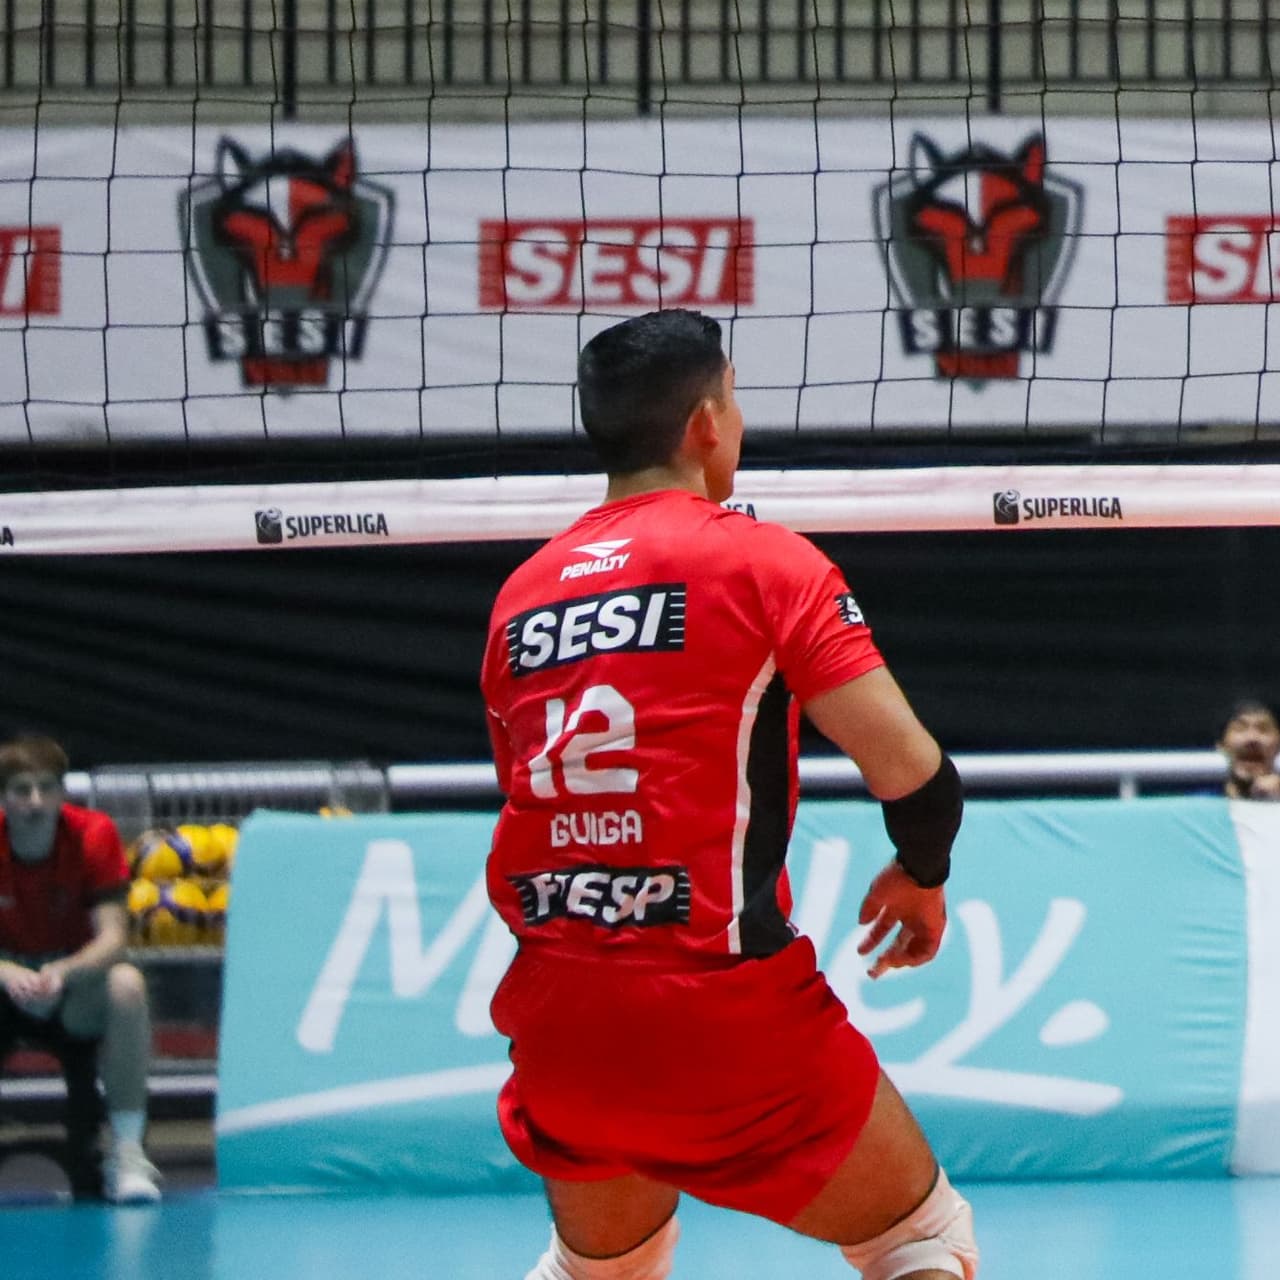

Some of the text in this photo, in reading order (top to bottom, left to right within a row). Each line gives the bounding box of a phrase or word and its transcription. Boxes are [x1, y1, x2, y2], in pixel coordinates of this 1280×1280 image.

[505, 228, 731, 301] SESI
[286, 515, 388, 539] SUPERLIGA
[1024, 499, 1122, 520] SUPERLIGA
[560, 553, 630, 581] PENALTY
[519, 592, 667, 669] SESI
[528, 685, 639, 798] 12
[551, 810, 642, 847] GUIGA
